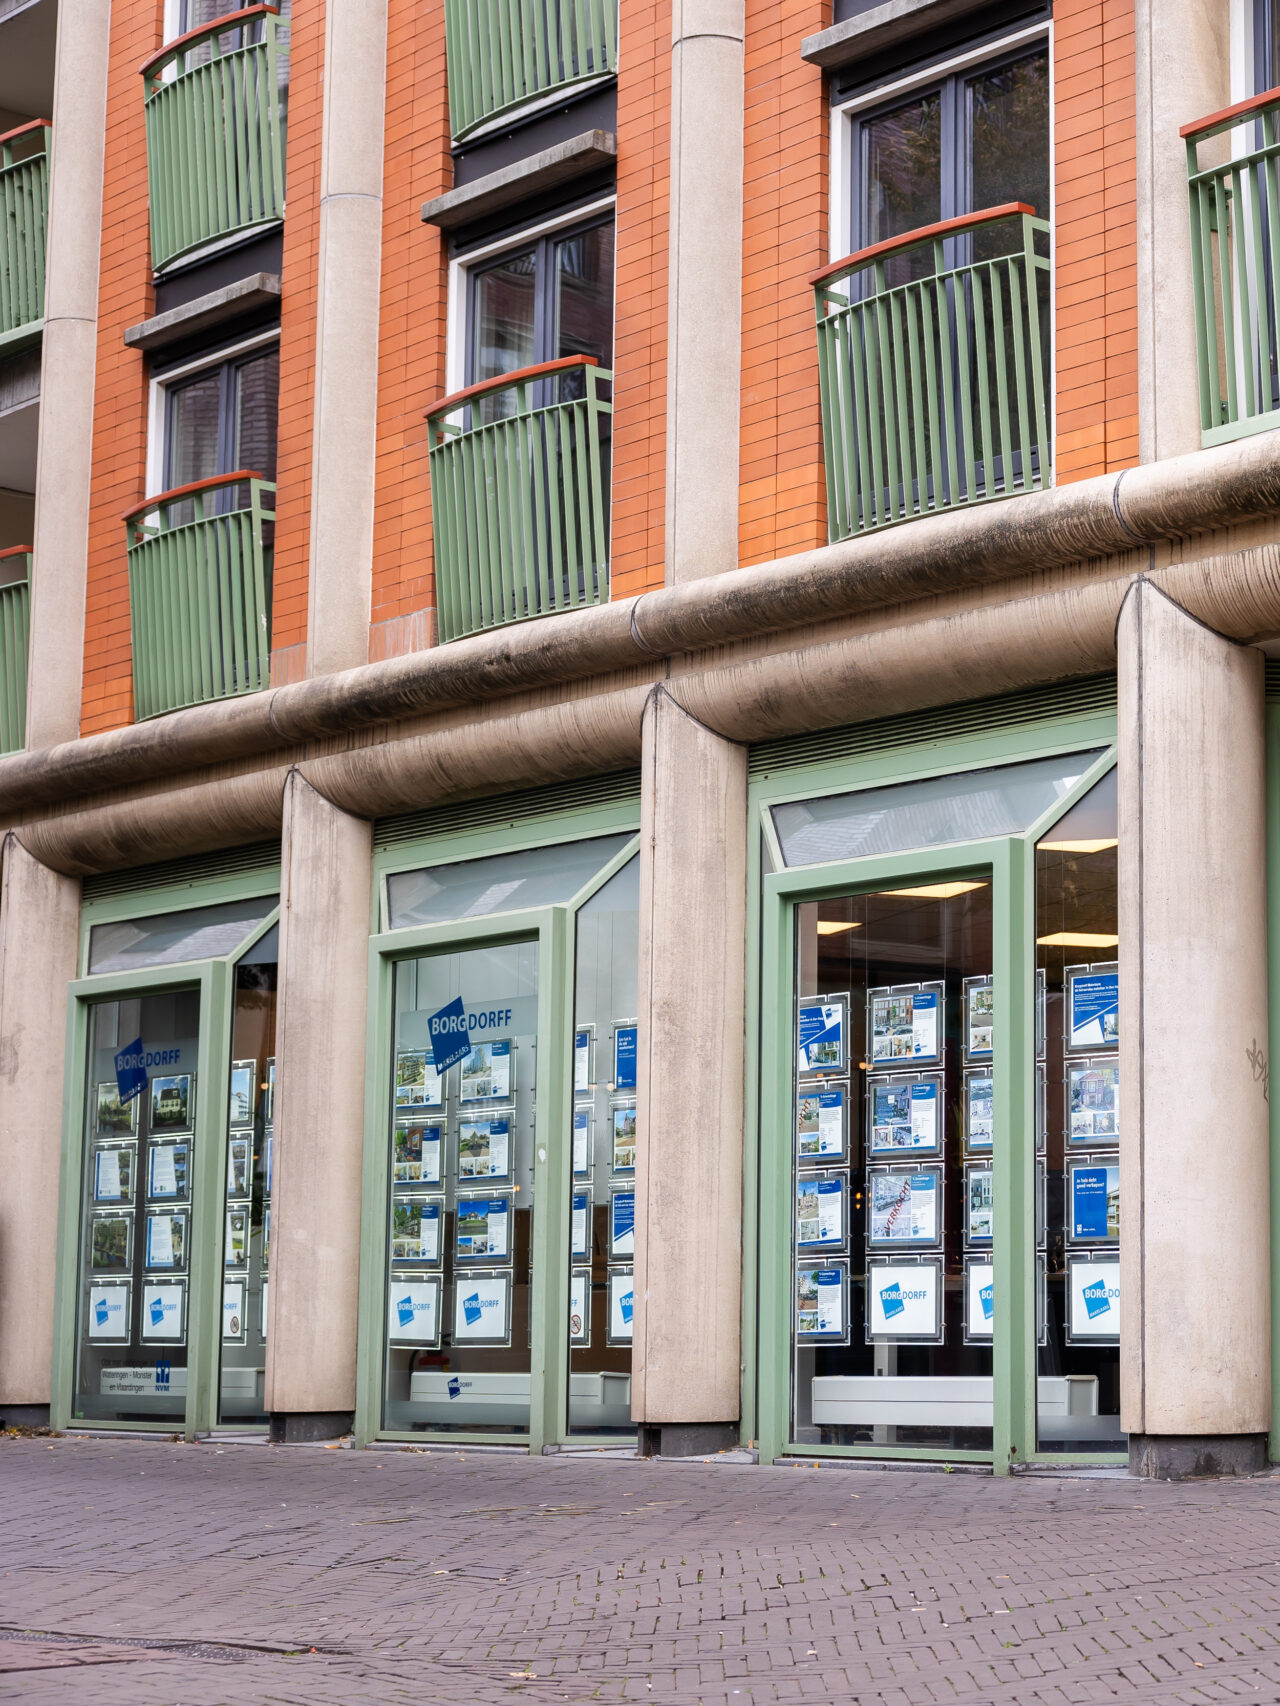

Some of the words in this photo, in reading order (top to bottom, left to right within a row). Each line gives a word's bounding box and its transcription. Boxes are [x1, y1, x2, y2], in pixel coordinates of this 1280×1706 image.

[431, 1008, 512, 1036] BORGDORFF
[117, 1049, 180, 1071] BORGDORFF
[882, 1290, 927, 1300] BORGDORFF
[1085, 1288, 1120, 1298] BORGDO
